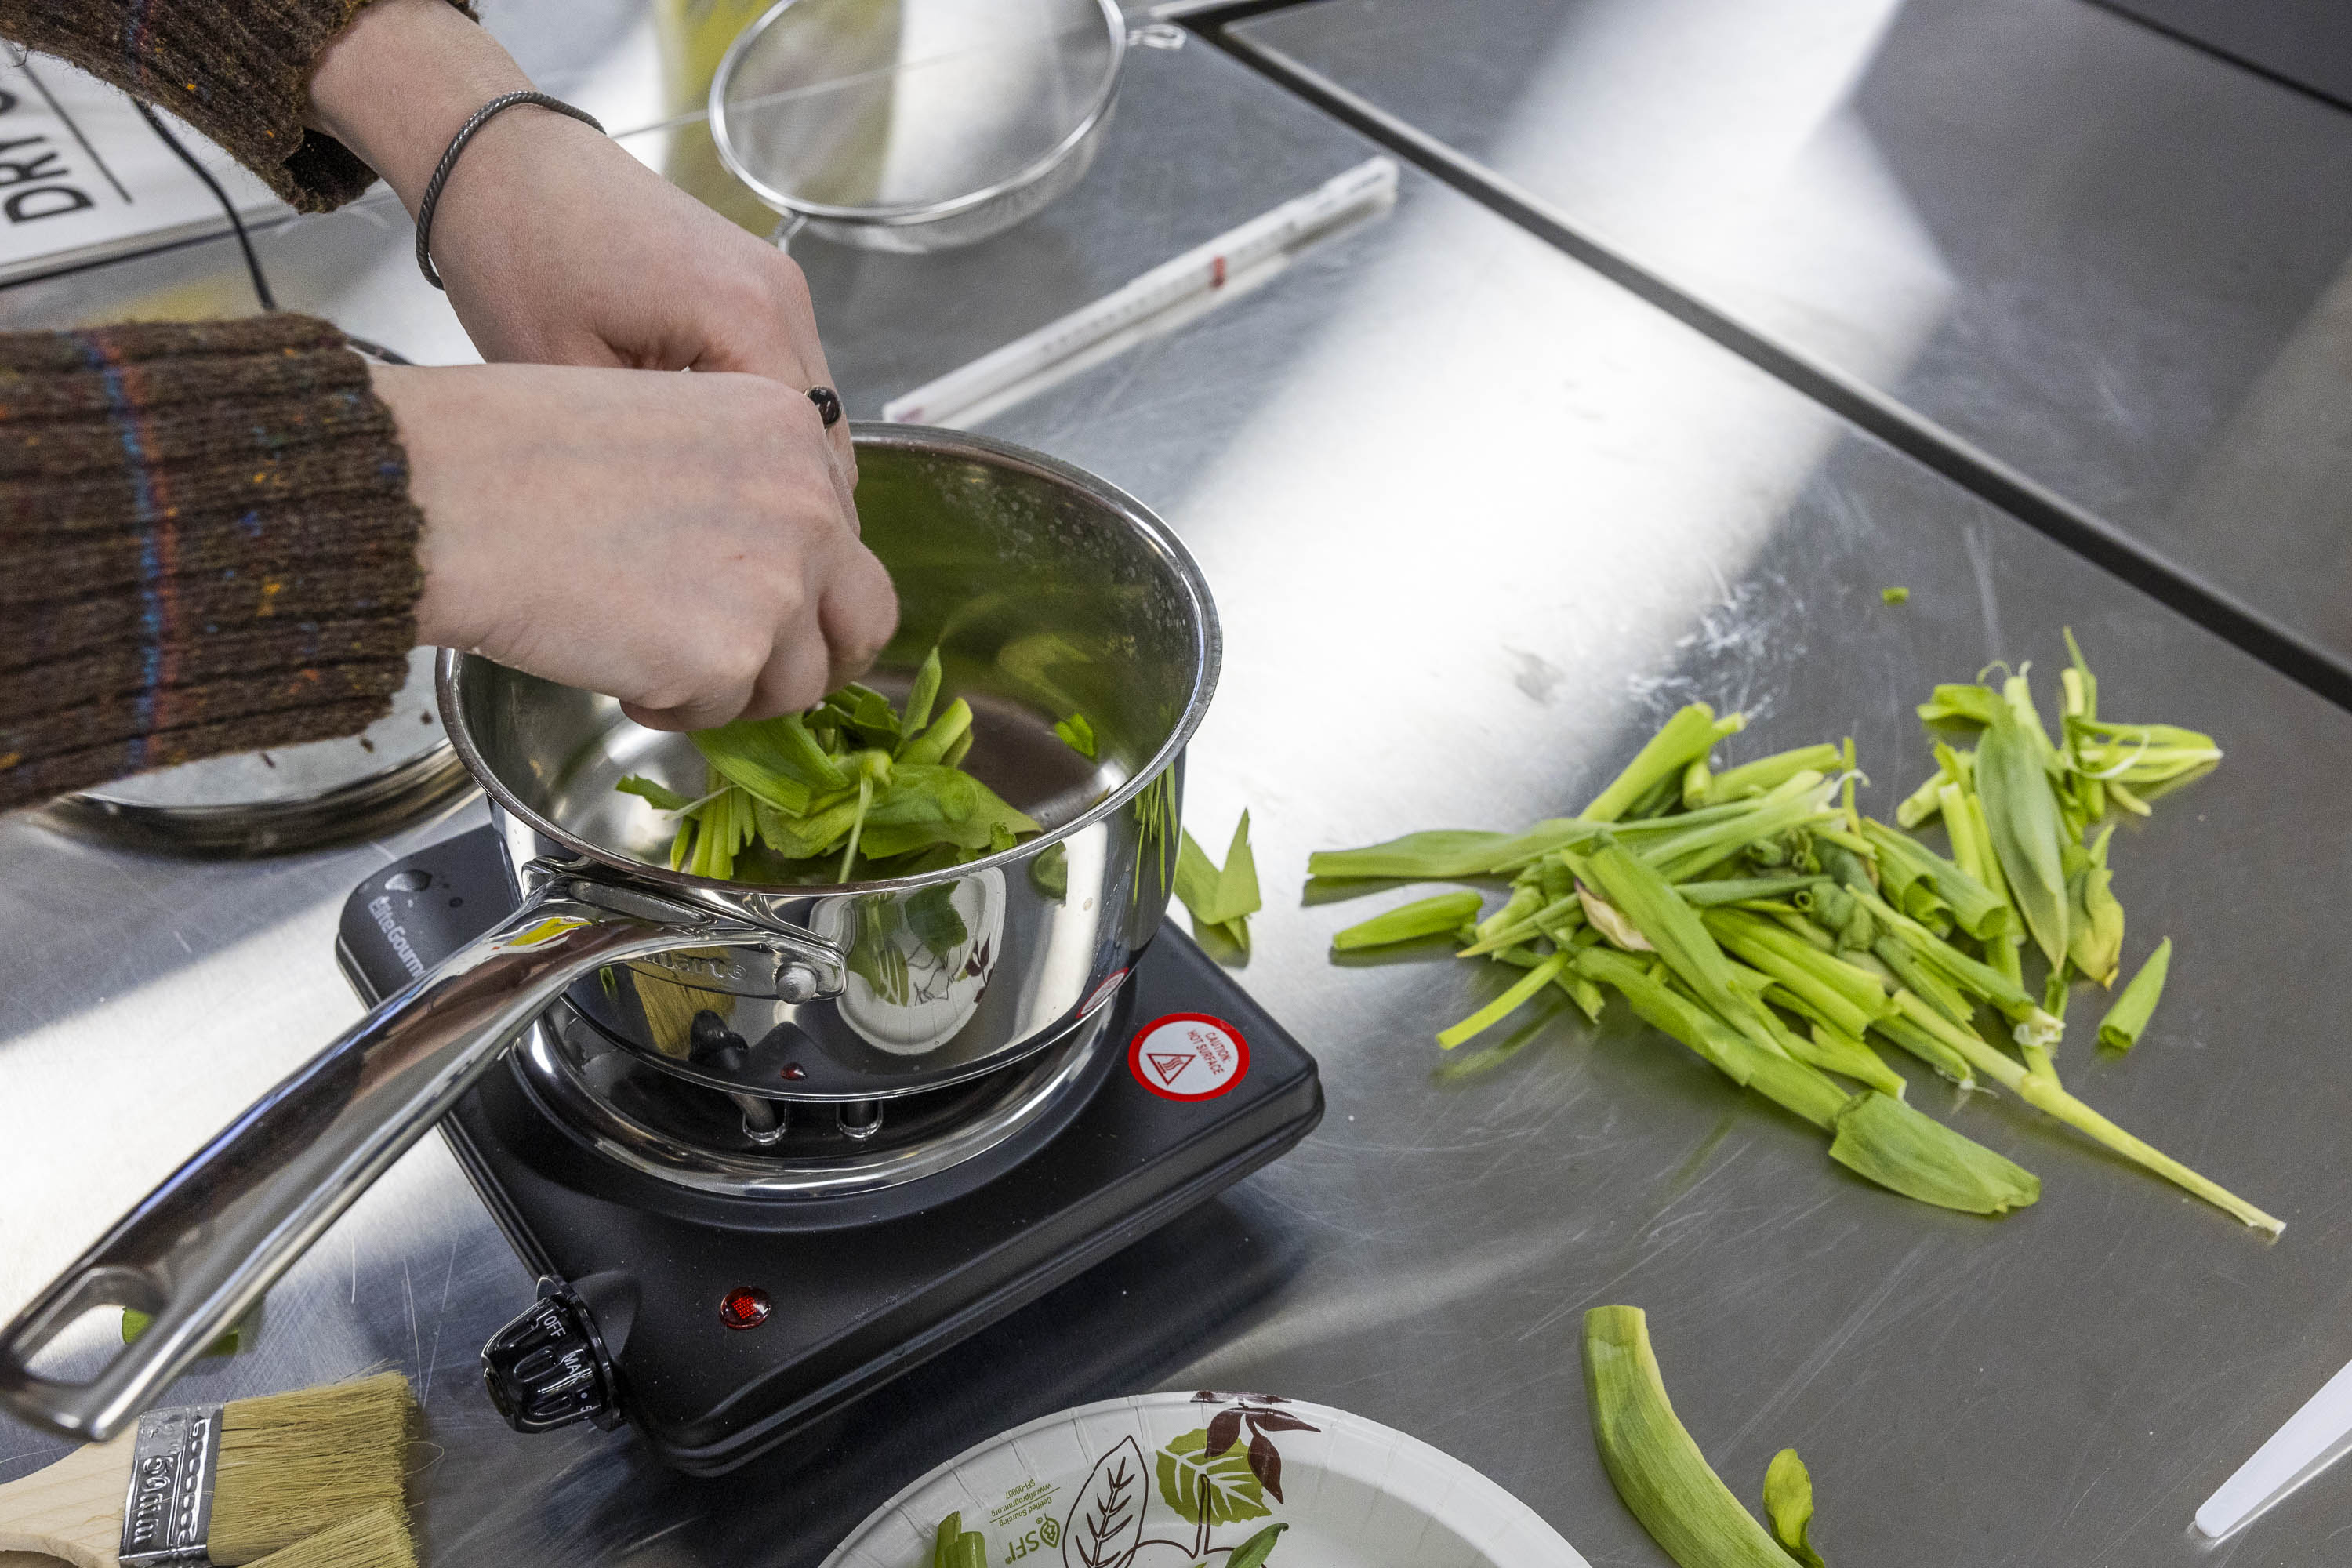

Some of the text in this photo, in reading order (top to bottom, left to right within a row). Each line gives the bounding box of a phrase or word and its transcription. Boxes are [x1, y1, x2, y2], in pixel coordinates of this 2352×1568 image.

[1187, 1029, 1225, 1075] HOT SURFACE
[1205, 1031, 1231, 1062] CAUTION
[543, 1316, 566, 1337] OFF
[564, 1352, 586, 1385] MAX
[990, 1483, 1052, 1517] www.sfiprogram.org
[1005, 1479, 1036, 1500] SFI-00007
[999, 1509, 1028, 1527] Sourcing
